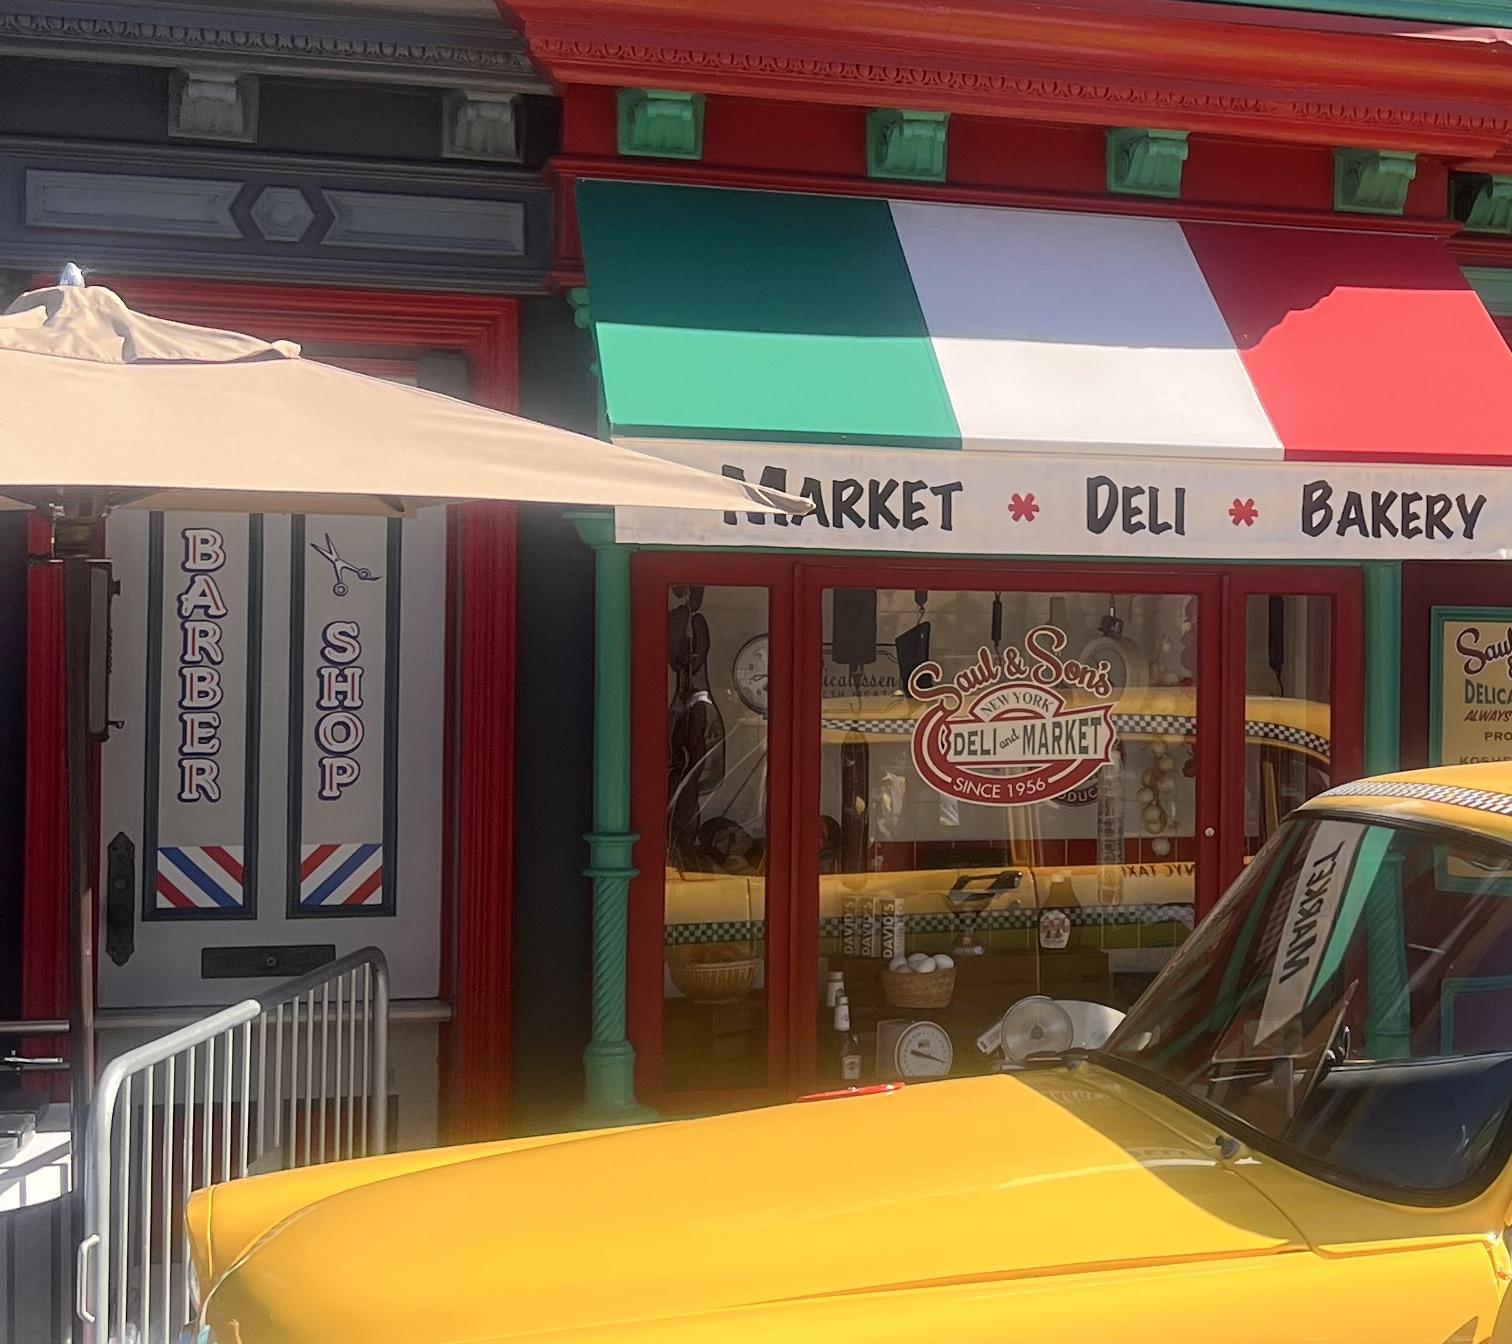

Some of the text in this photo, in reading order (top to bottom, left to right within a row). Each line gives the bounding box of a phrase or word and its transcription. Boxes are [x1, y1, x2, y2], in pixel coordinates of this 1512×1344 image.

[1086, 475, 1187, 537] DELI
[1301, 480, 1488, 540] BAKERY
[177, 527, 228, 802] BARBER
[909, 626, 1113, 718] Saul & Son's
[315, 621, 364, 801] SHOP
[980, 691, 1055, 716] NEW YORK
[1464, 710, 1512, 722] ALWAYS
[954, 716, 1103, 757] DELI and MARKET
[953, 777, 1001, 799] SINCE
[1006, 777, 1046, 798] 1956
